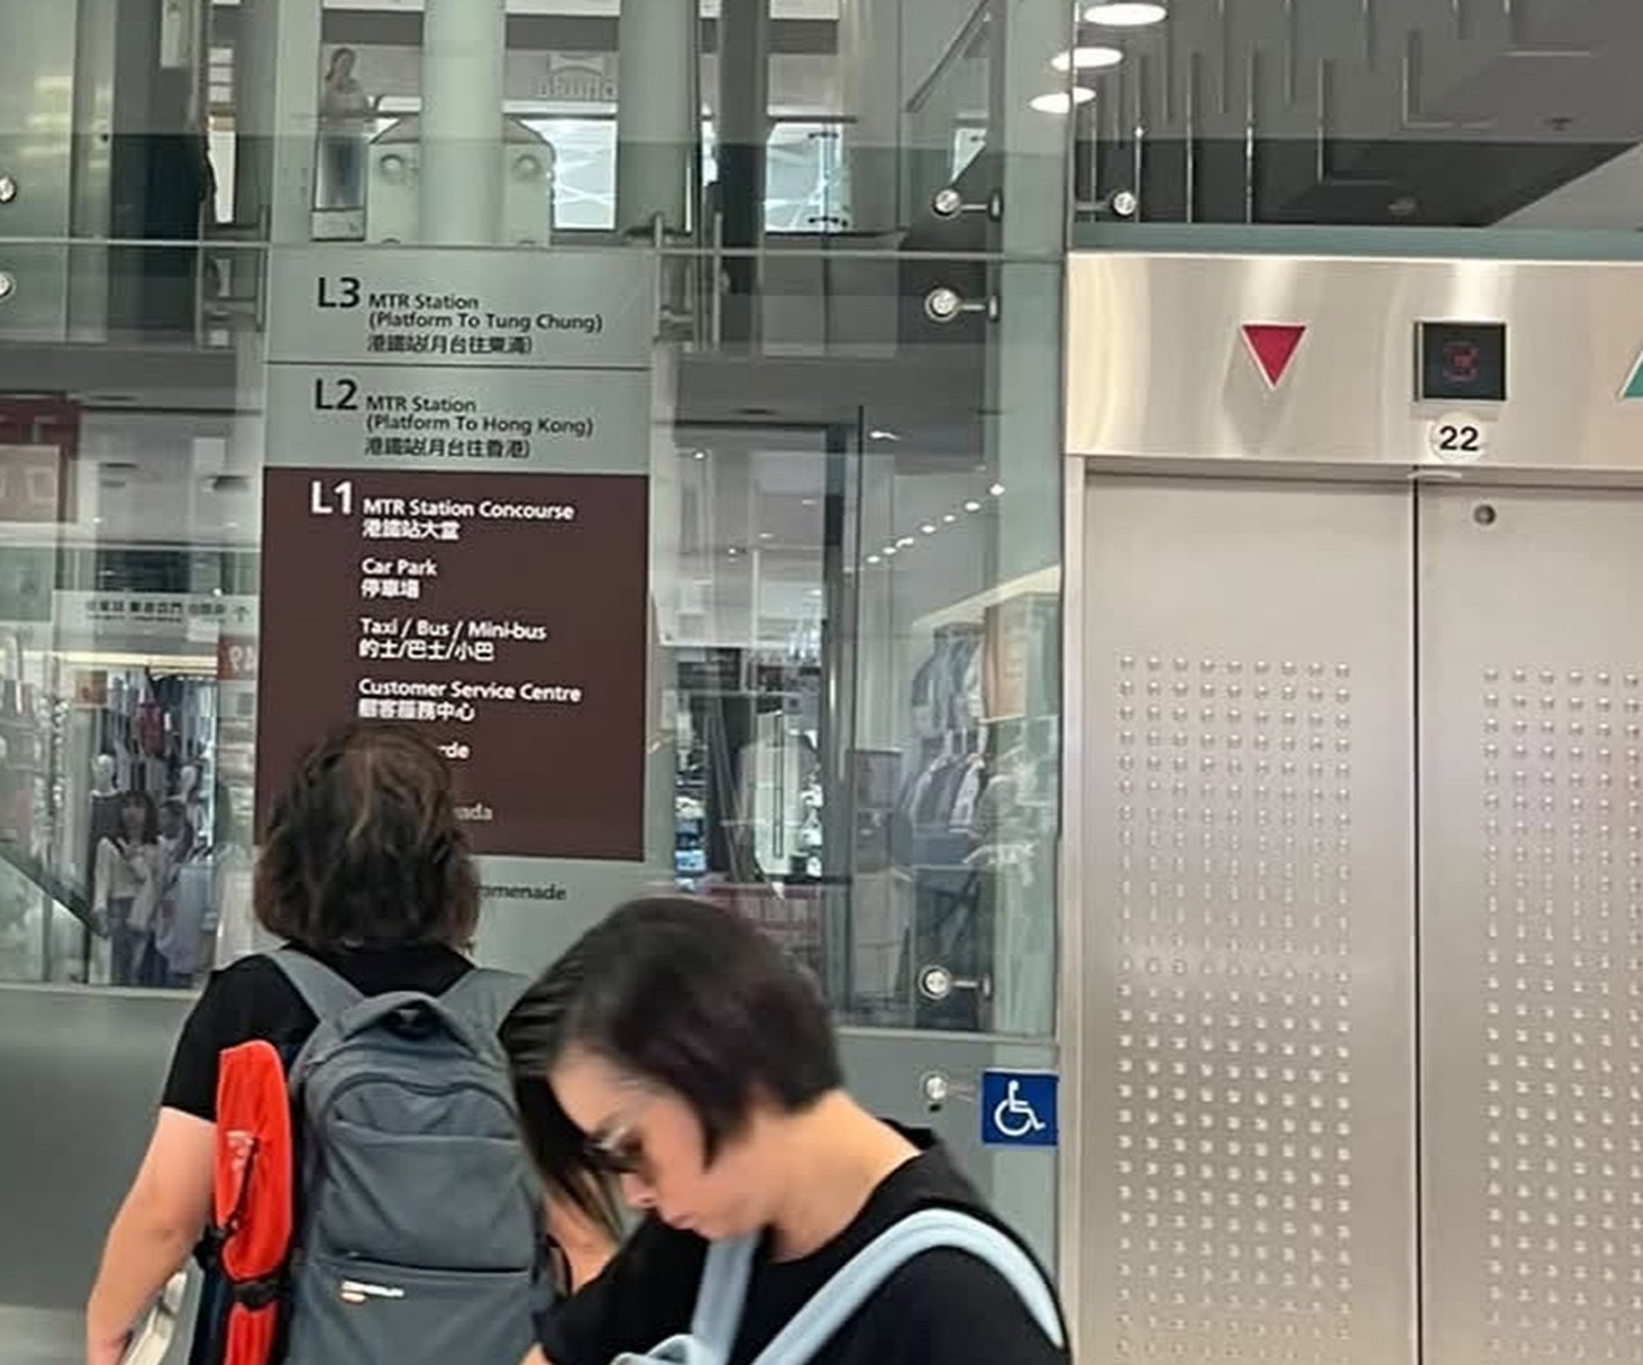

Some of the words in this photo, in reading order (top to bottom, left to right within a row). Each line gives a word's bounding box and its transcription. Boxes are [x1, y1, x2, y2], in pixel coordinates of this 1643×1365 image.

[317, 277, 361, 308] L3
[368, 294, 410, 308] MTR
[414, 294, 479, 309] Station
[368, 311, 453, 329] (Platform
[457, 313, 481, 328] To
[485, 313, 532, 333] Tung
[535, 314, 603, 333] Chung)
[314, 379, 359, 410] L2
[365, 396, 407, 411] MTR
[411, 396, 477, 412] Station
[365, 414, 451, 433] (Platform
[455, 416, 479, 431] To
[482, 417, 533, 436] Hong
[537, 418, 594, 437] Kong)
[1439, 426, 1480, 451] 22
[311, 481, 352, 514] L1
[363, 499, 405, 514] MTR
[409, 499, 475, 516] Station
[478, 501, 575, 519] Concourse
[361, 558, 393, 574] Car
[397, 559, 437, 575] Park
[360, 618, 398, 634] Taxi
[416, 620, 450, 636] Bus
[467, 621, 547, 639] Mini-bus
[358, 678, 447, 697] Customer
[450, 681, 516, 699] Service
[519, 684, 582, 702] Centre
[477, 884, 567, 901] omenade
